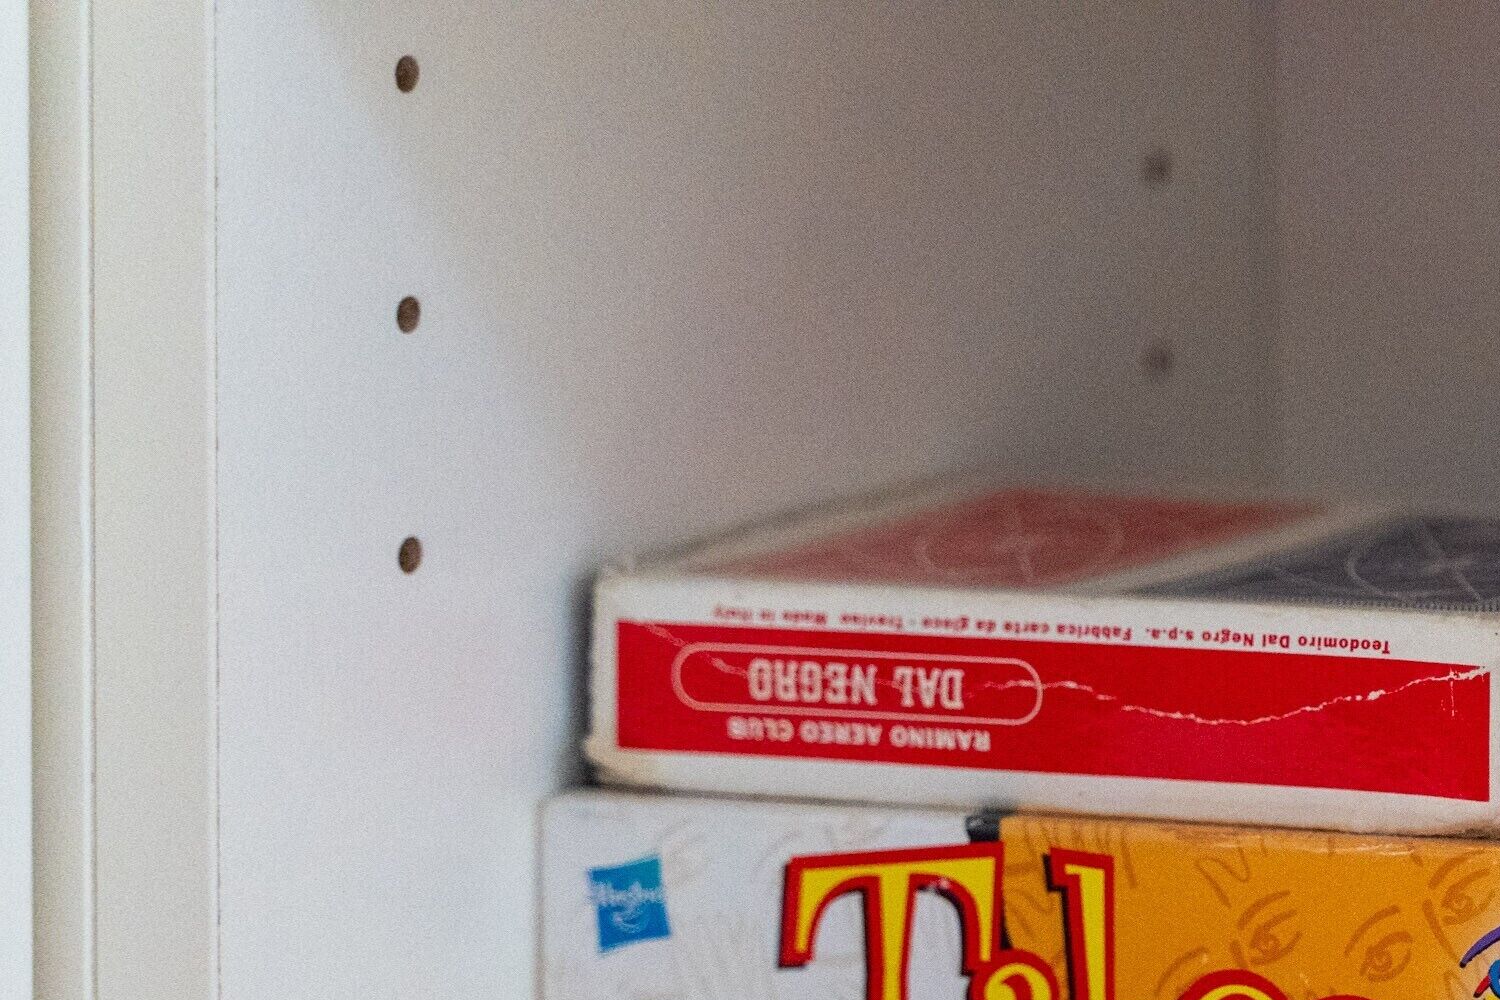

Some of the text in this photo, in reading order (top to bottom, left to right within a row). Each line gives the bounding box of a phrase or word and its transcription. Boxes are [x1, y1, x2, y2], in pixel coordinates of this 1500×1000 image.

[1056, 622, 1133, 642] Fabbrica
[1202, 627, 1255, 647] Negro
[1262, 633, 1290, 649] Dal
[1297, 634, 1391, 655] Teodomiro
[746, 656, 966, 710] DAL NEGRO
[726, 715, 992, 752] RAMINO AEREO CLUB
